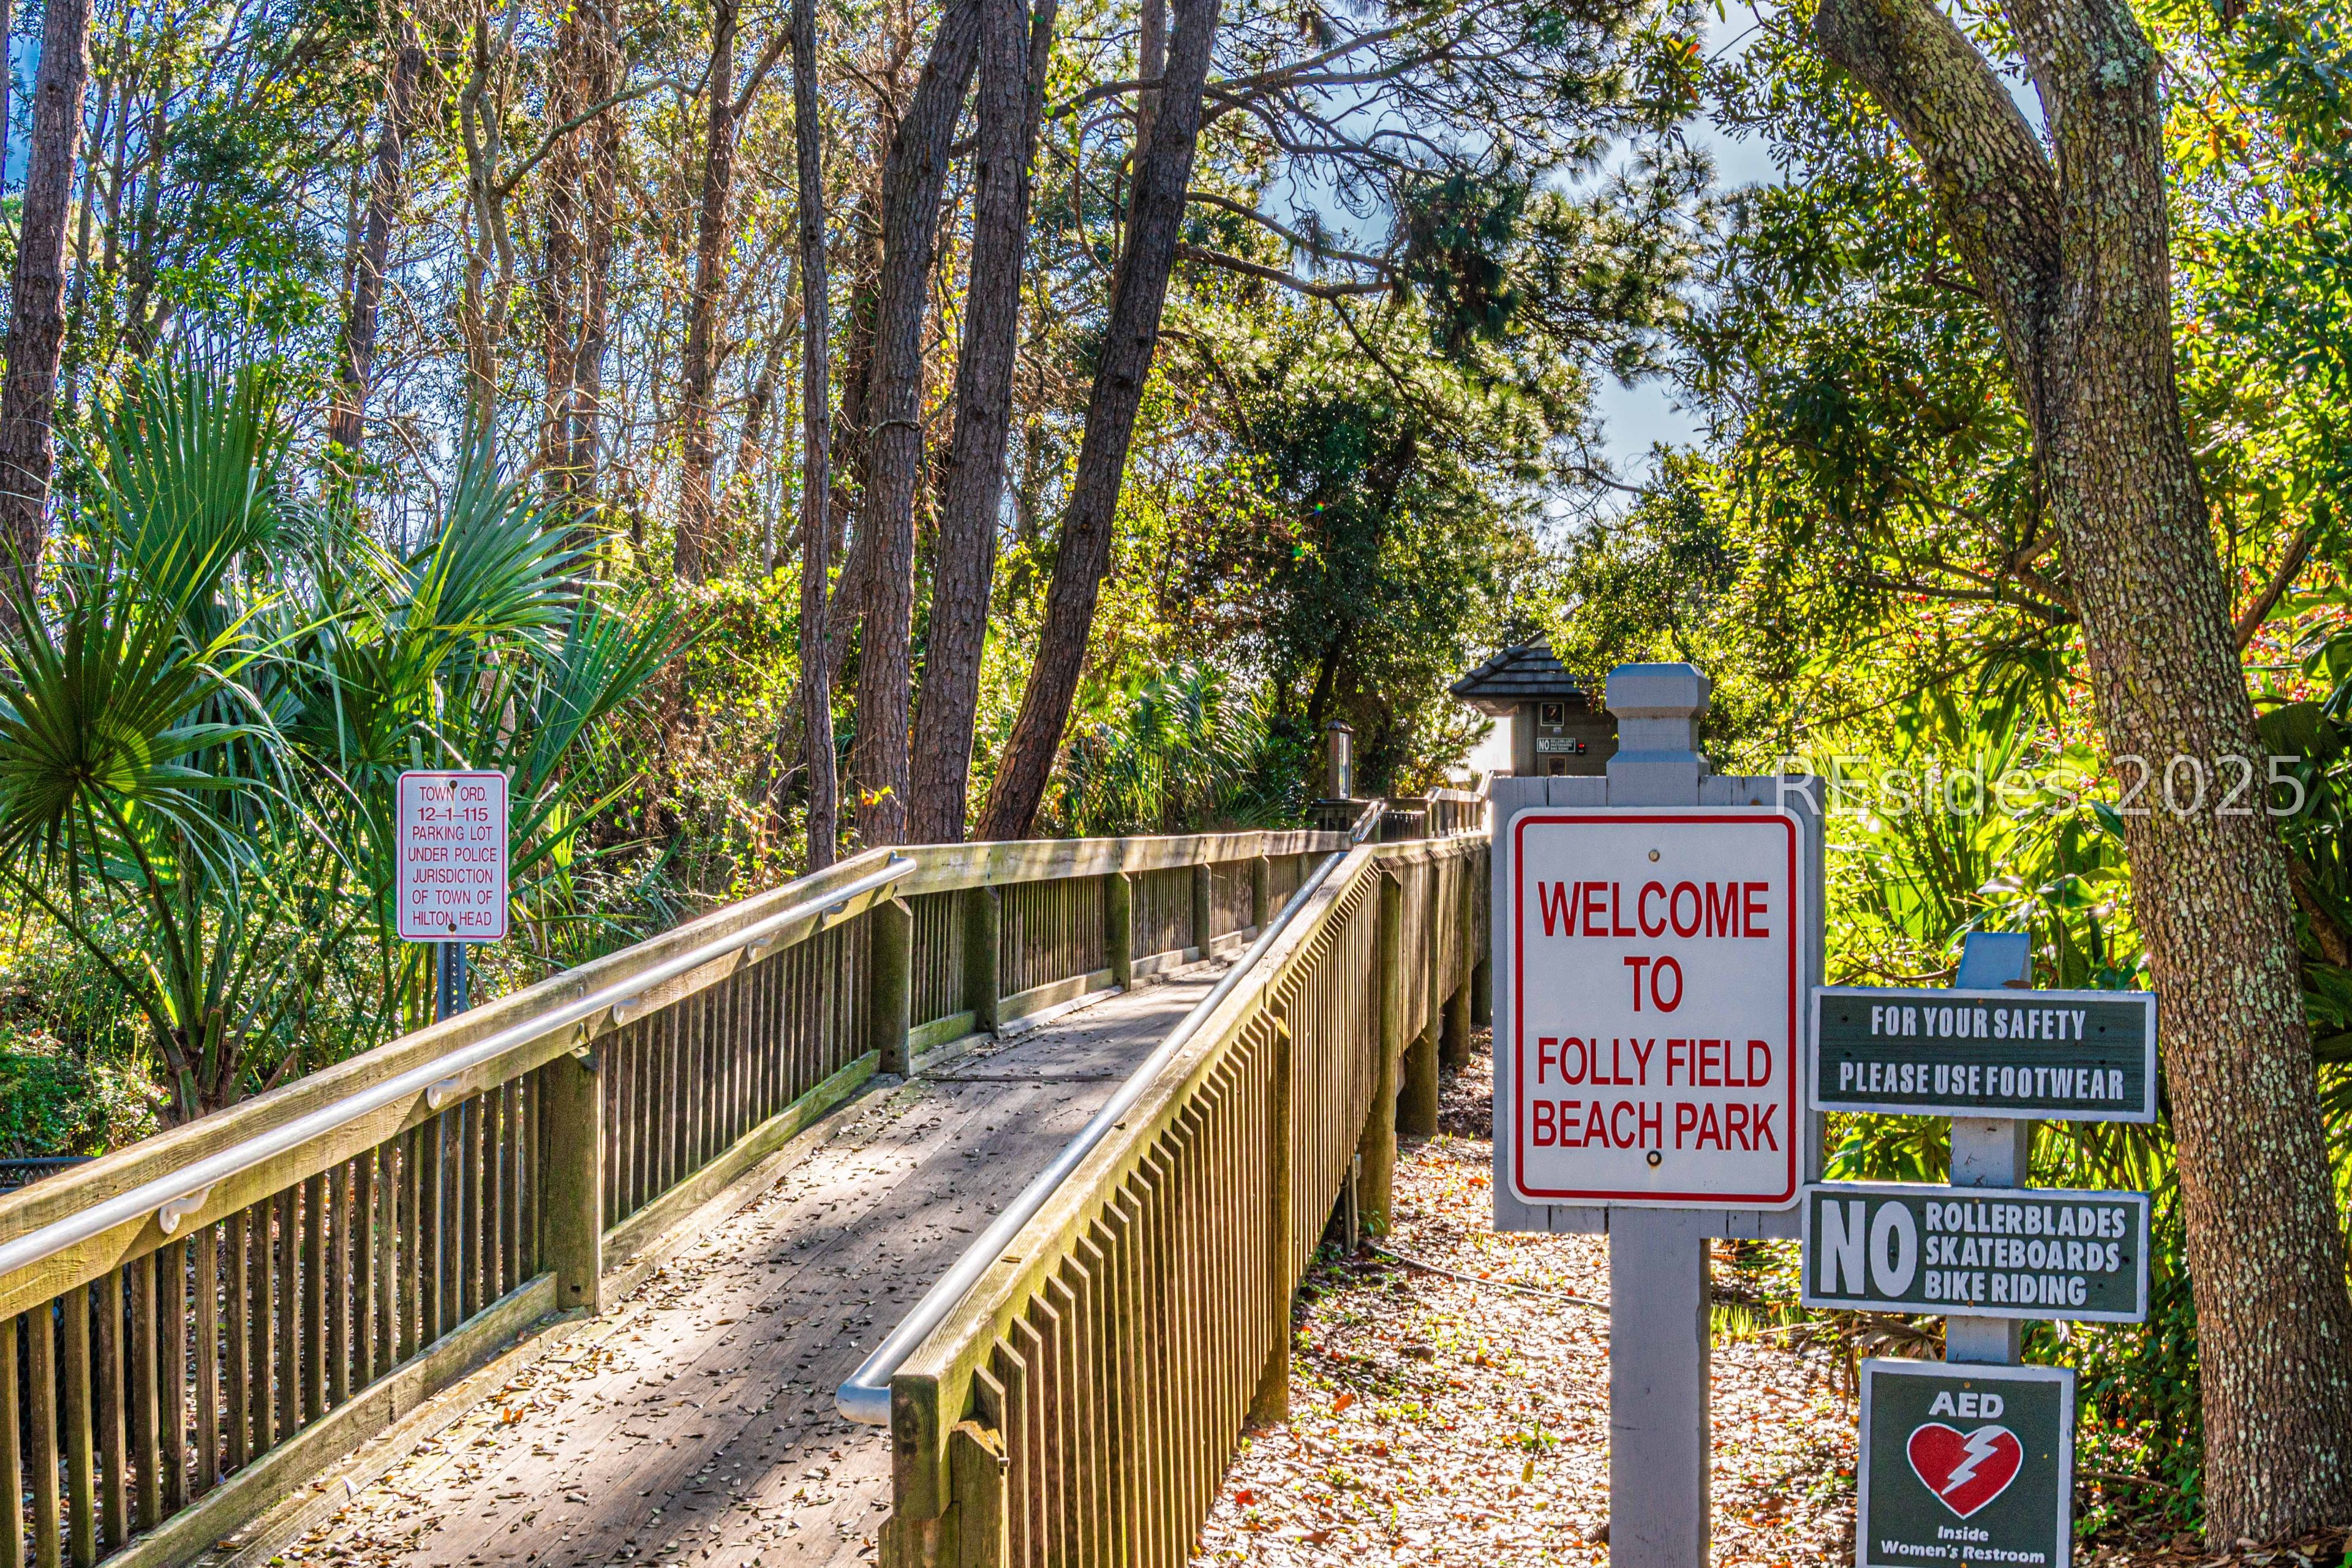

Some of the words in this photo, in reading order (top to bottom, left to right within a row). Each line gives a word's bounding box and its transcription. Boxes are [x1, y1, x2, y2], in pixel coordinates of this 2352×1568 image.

[1539, 739, 1550, 750] NO
[420, 786, 454, 801] TOWN
[461, 787, 487, 801] ORD.
[413, 826, 463, 840] PARKING
[470, 826, 492, 840] LOT
[409, 848, 448, 861] UNDER
[455, 848, 497, 862] POLICE
[413, 869, 492, 883] JURISDICTION
[413, 891, 428, 904] OF
[437, 890, 470, 904] TOWN
[477, 890, 492, 904] OF
[1539, 881, 1769, 938] WELCOME
[413, 911, 453, 925] HILTON
[460, 911, 491, 925] HEAD
[1624, 956, 1683, 1012] TO
[1872, 1006, 1916, 1035] FOR
[1924, 1008, 1988, 1037] YOUR
[1994, 1009, 2085, 1039] SAFETY
[1539, 1038, 1654, 1085] FOLLY
[1667, 1039, 1771, 1087] FIELD
[1841, 1063, 1928, 1093] PLEASE
[1935, 1065, 1979, 1095] USE
[1987, 1067, 2122, 1099] FOOTWEAR
[1533, 1100, 1662, 1148] BEACH
[1676, 1102, 1777, 1151] PARK
[1926, 1201, 2126, 1238] ROLLERBLADES
[1821, 1200, 1917, 1297] NO
[1926, 1235, 2120, 1273] SKATEBOARDS
[1925, 1271, 1985, 1300] BIKE
[1991, 1275, 2087, 1305] RIDING
[1929, 1392, 2003, 1418] AED
[1938, 1526, 1988, 1540] Inside
[1881, 1540, 1959, 1559] Women's
[1962, 1545, 2045, 1563] Restroom
